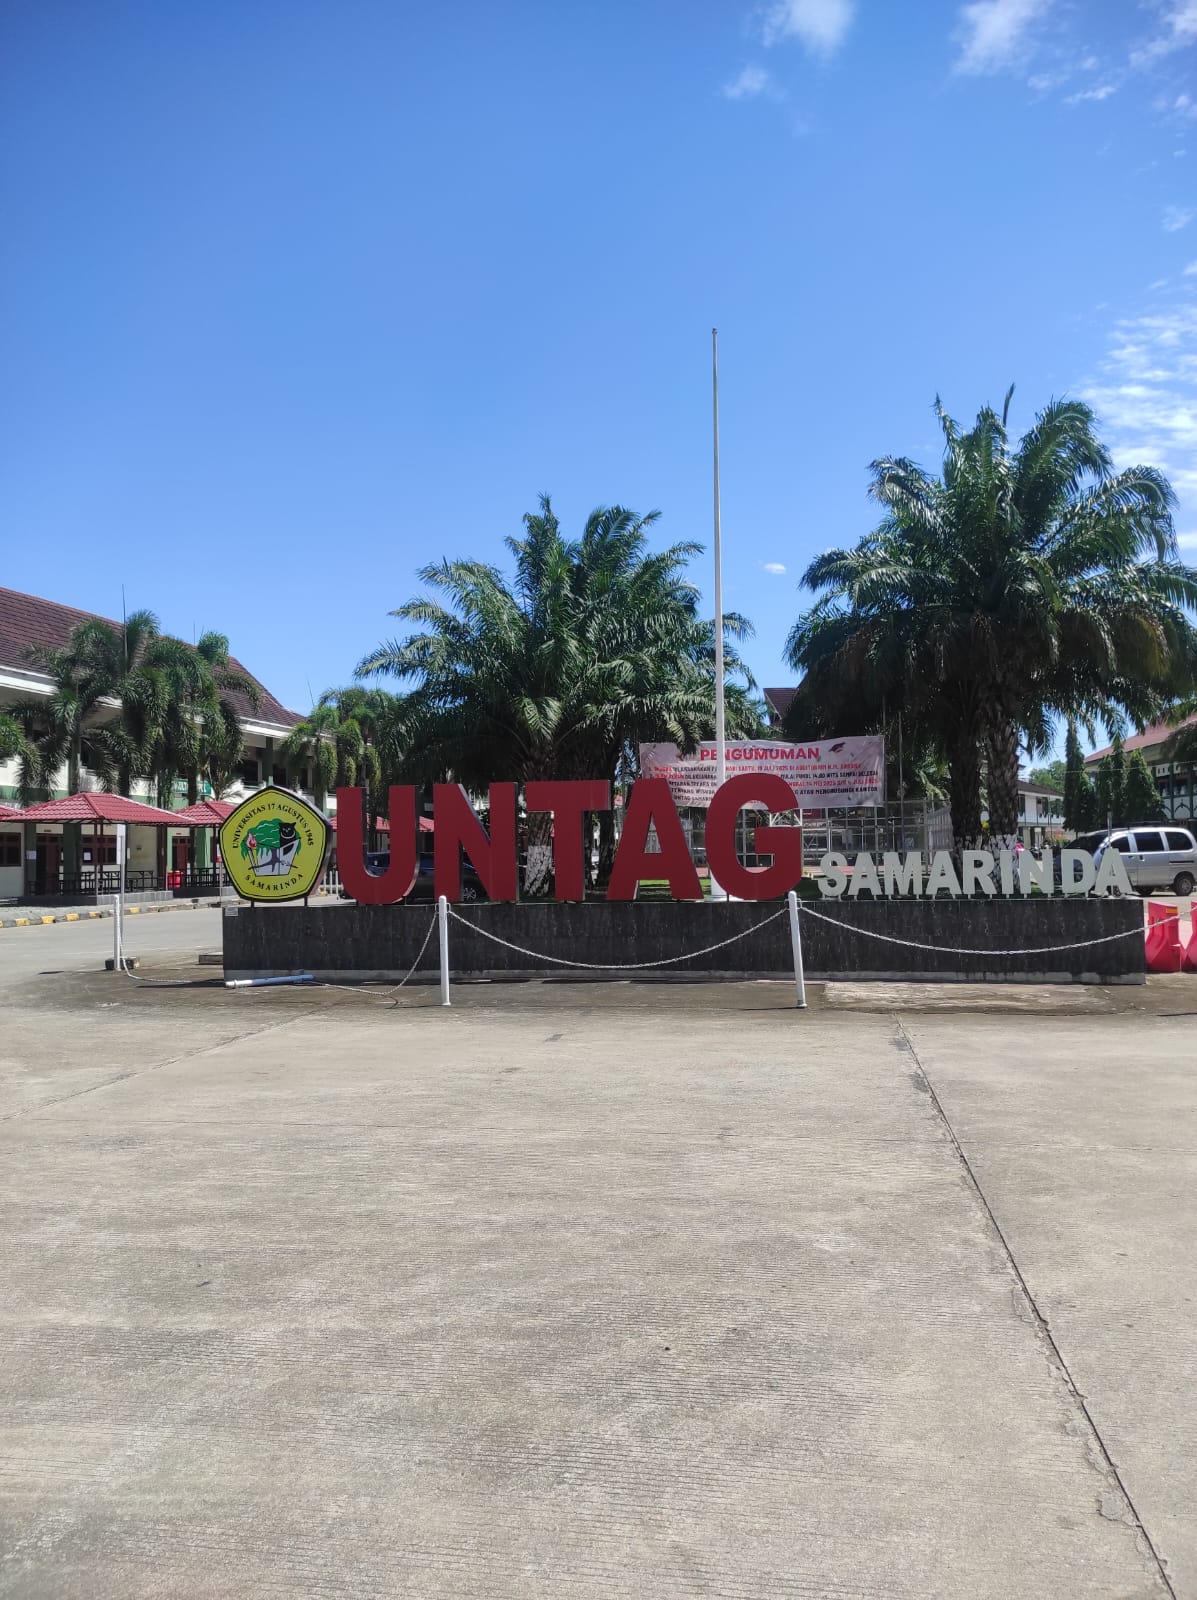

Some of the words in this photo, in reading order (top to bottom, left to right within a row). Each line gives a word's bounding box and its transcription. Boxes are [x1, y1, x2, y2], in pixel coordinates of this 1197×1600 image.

[700, 747, 819, 761] PENGUMUMAN
[232, 804, 266, 849] UNIVERSITAS
[267, 803, 276, 811] 17
[277, 804, 308, 829] AGUSTUS
[304, 829, 314, 846] 1945
[336, 772, 802, 905] UNTAG
[817, 848, 1133, 897] SAMARINDA
[245, 873, 304, 891] SAMARINDA
